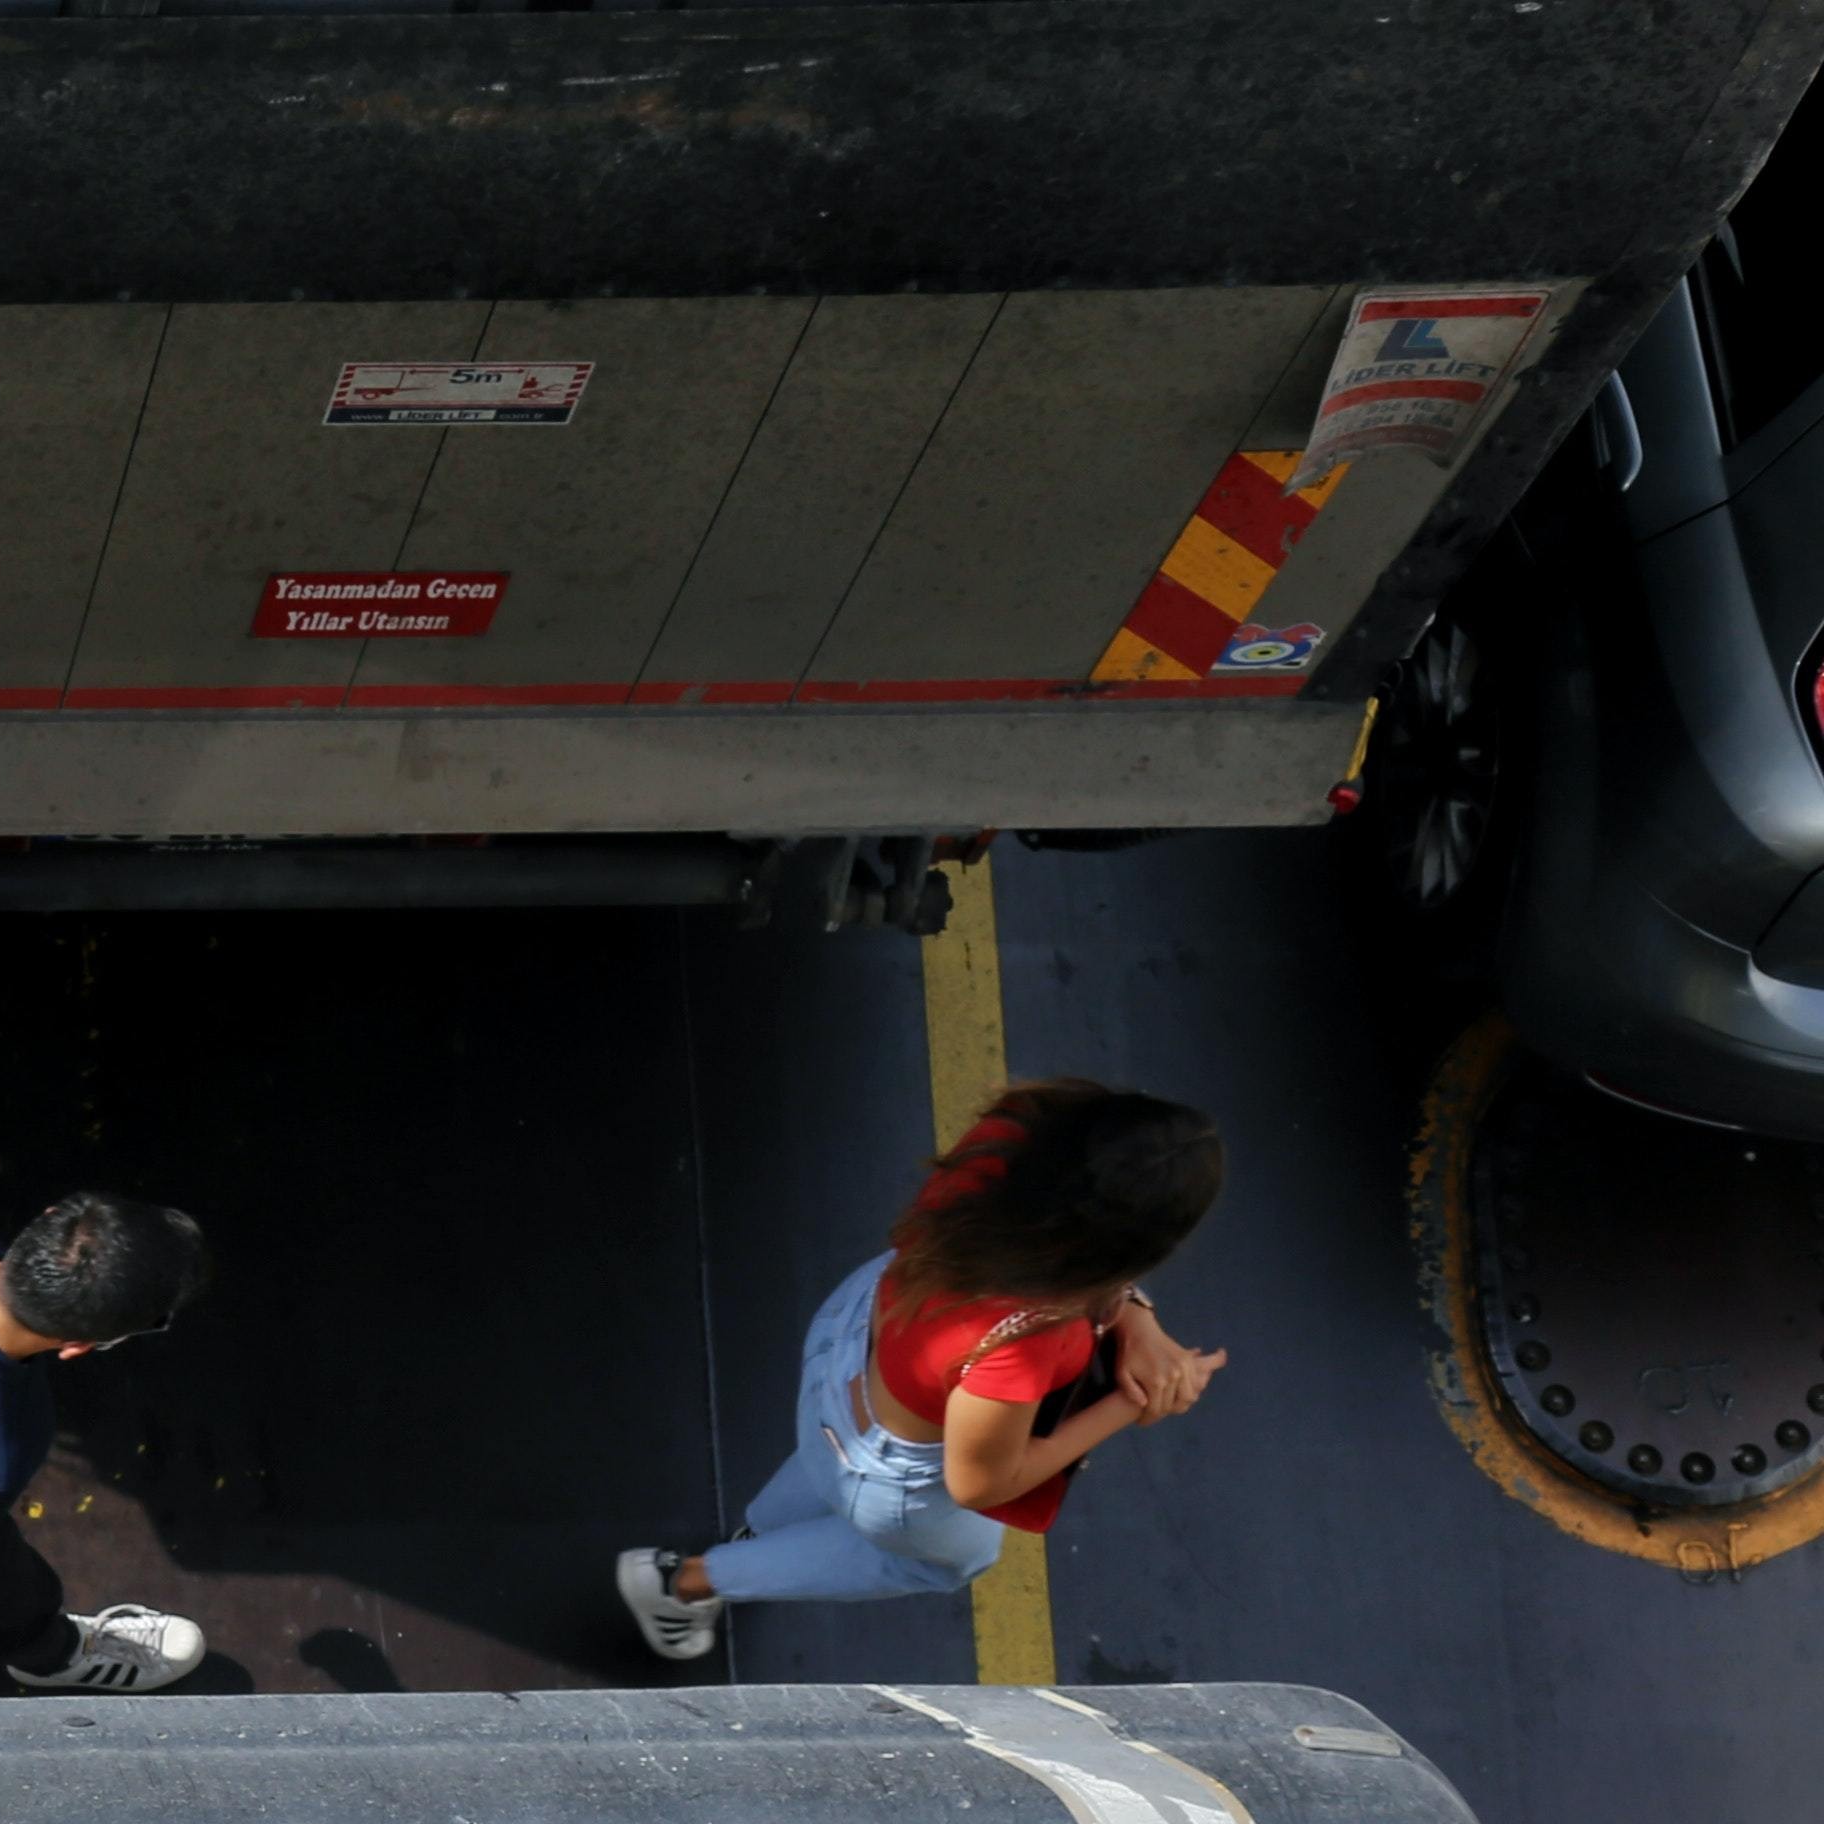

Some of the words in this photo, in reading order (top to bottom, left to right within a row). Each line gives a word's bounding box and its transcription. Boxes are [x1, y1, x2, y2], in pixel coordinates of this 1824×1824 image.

[449, 368, 503, 384] 5m
[285, 610, 354, 632] Yıllar
[358, 610, 450, 632] Utansın
